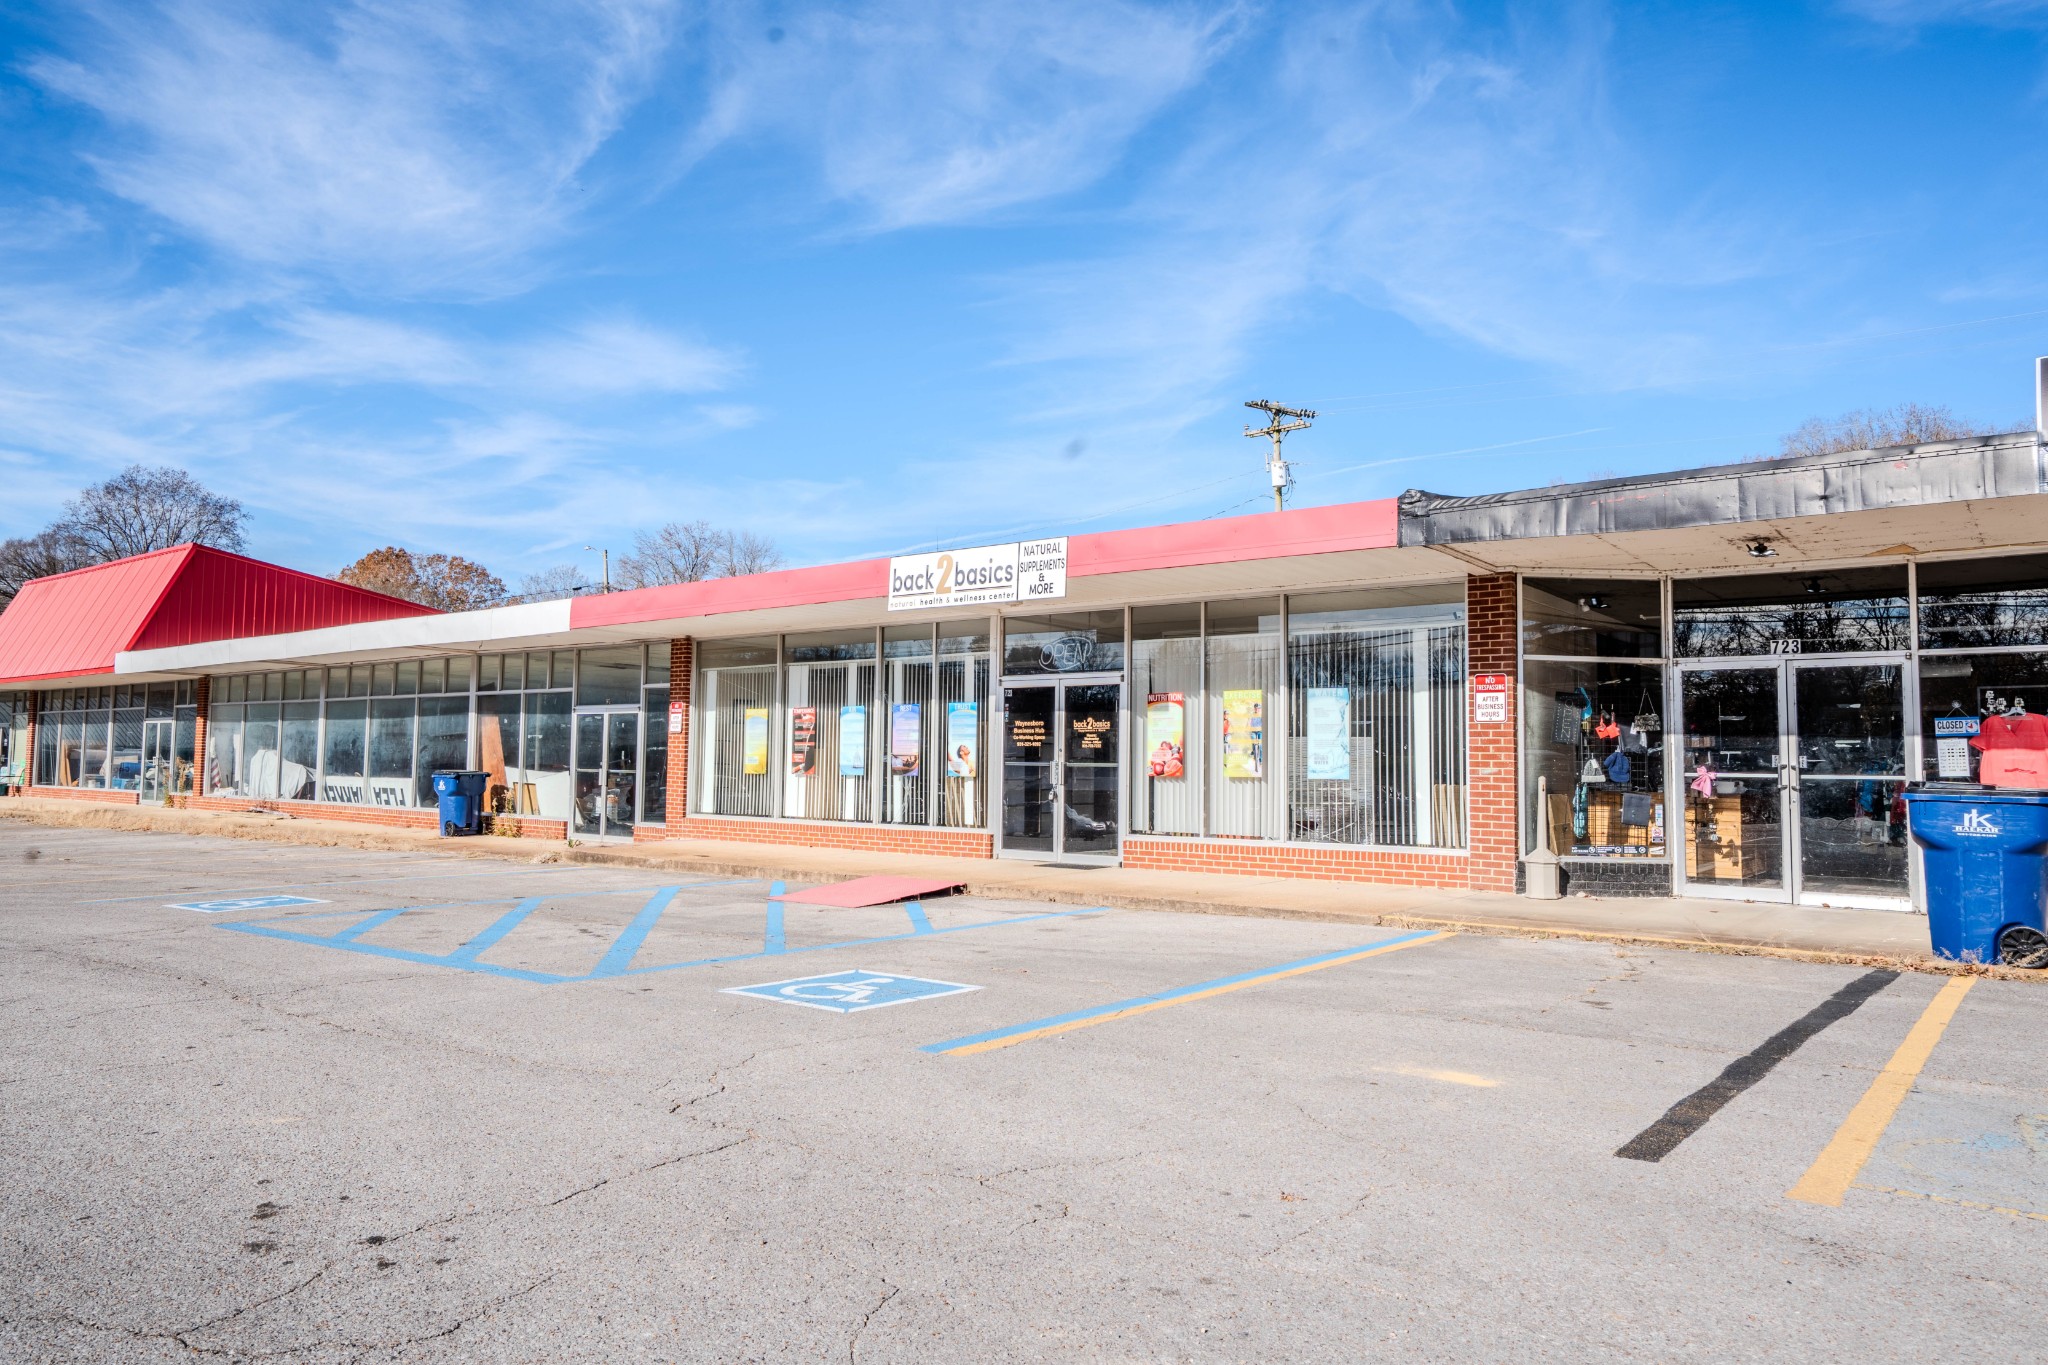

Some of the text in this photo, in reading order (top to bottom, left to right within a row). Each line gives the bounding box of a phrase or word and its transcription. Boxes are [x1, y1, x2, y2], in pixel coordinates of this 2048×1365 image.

[1023, 542, 1062, 557] NATURAL
[1020, 558, 1065, 573] SUPPLEMENTS
[1038, 572, 1045, 582] &
[1029, 582, 1054, 595] MORE
[890, 600, 916, 608] natural
[919, 597, 943, 606] health
[953, 593, 986, 603] wellness
[989, 592, 1015, 600] center
[1041, 643, 1089, 665] OPEN
[1771, 640, 1800, 654] 723
[1148, 693, 1182, 702] NUTRITION
[1937, 721, 1964, 730] CLOSED
